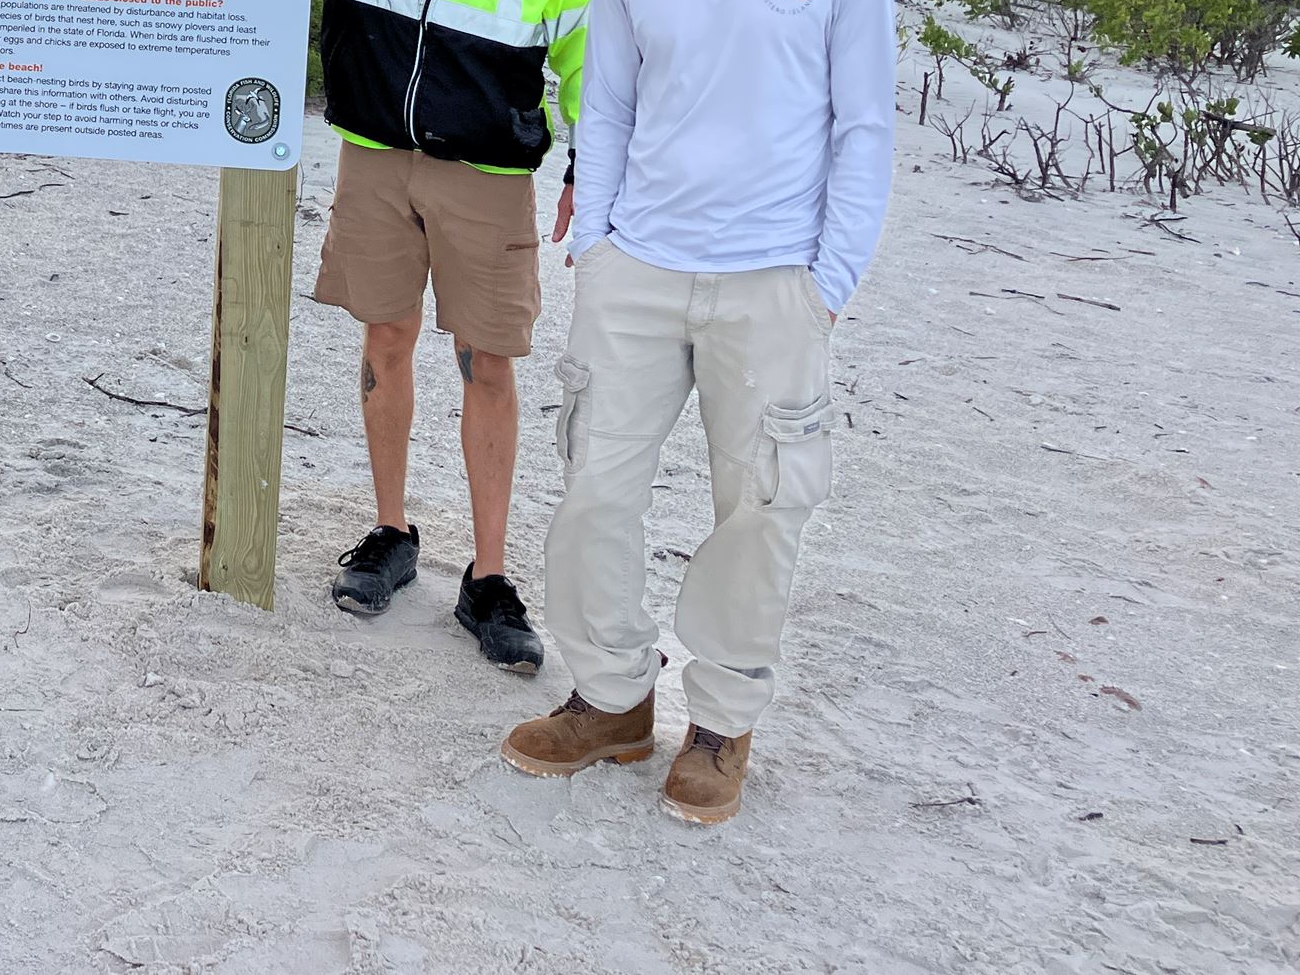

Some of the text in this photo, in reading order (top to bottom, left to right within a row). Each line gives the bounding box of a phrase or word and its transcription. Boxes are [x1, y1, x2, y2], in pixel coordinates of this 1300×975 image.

[0, 1, 49, 10] populations
[67, 4, 111, 16] threatened
[114, 6, 124, 16] by
[126, 7, 176, 18] disturbance
[178, 10, 194, 20] and
[196, 11, 226, 20] habitat
[185, 0, 223, 8] public?
[24, 13, 33, 21] of
[35, 13, 56, 22] birds
[58, 15, 74, 23] that
[97, 17, 117, 27] here,
[120, 19, 140, 27] such
[155, 20, 183, 32] snowy
[185, 22, 215, 32] plovers
[218, 25, 234, 34] and
[236, 25, 256, 34] least
[8, 62, 43, 72] beach!
[7, 75, 66, 88] beach-nesting
[69, 78, 90, 88] birds
[92, 80, 102, 90] by
[104, 82, 134, 92] staying
[136, 85, 158, 93] away
[161, 84, 180, 93] from
[182, 87, 212, 95] posted
[227, 84, 240, 103] FLORIDA
[266, 85, 279, 106] WILDLIFE
[41, 125, 72, 133] present
[74, 127, 106, 136] outside
[107, 129, 137, 137] posted
[226, 112, 252, 142] CONSERVATION
